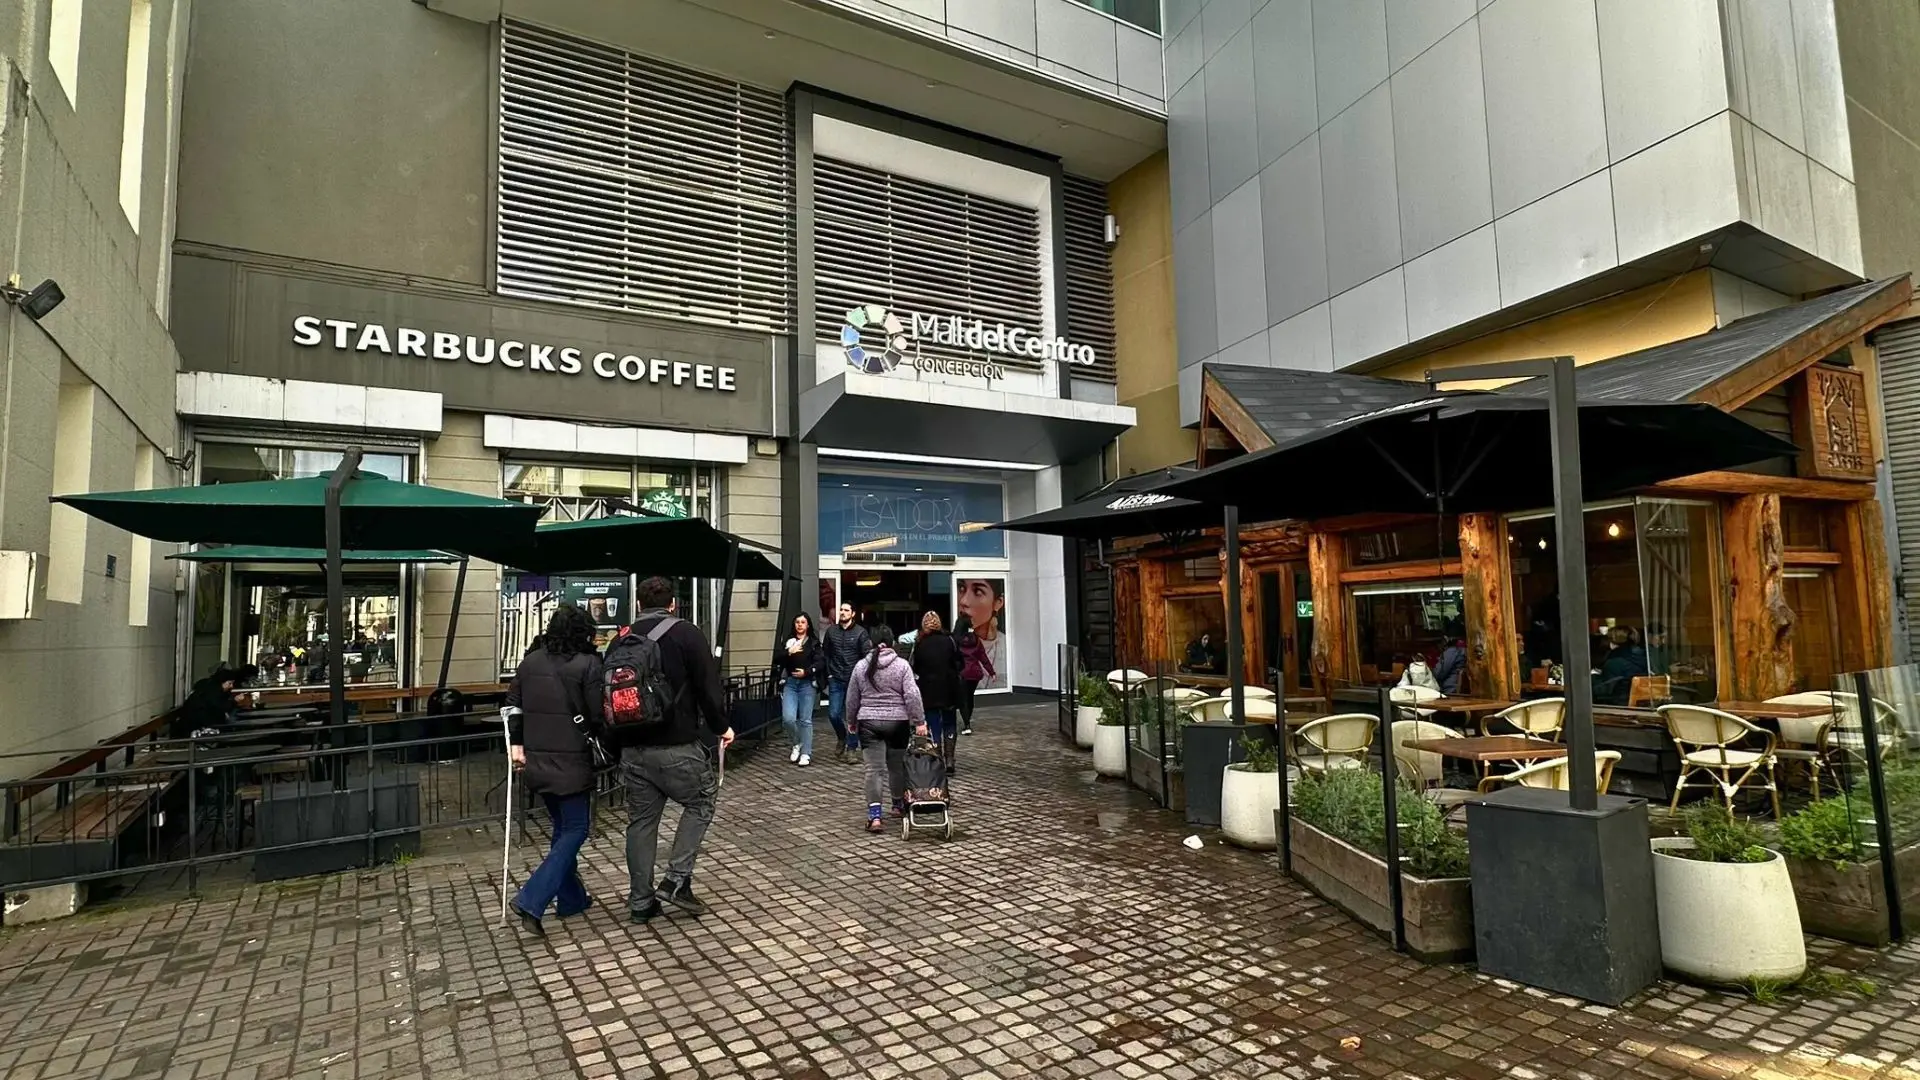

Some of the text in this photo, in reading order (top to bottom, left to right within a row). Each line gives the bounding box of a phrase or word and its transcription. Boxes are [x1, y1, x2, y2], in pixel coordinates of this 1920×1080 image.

[293, 315, 737, 392] STARBUCKS COFFEE
[848, 494, 967, 532] ISADORA
